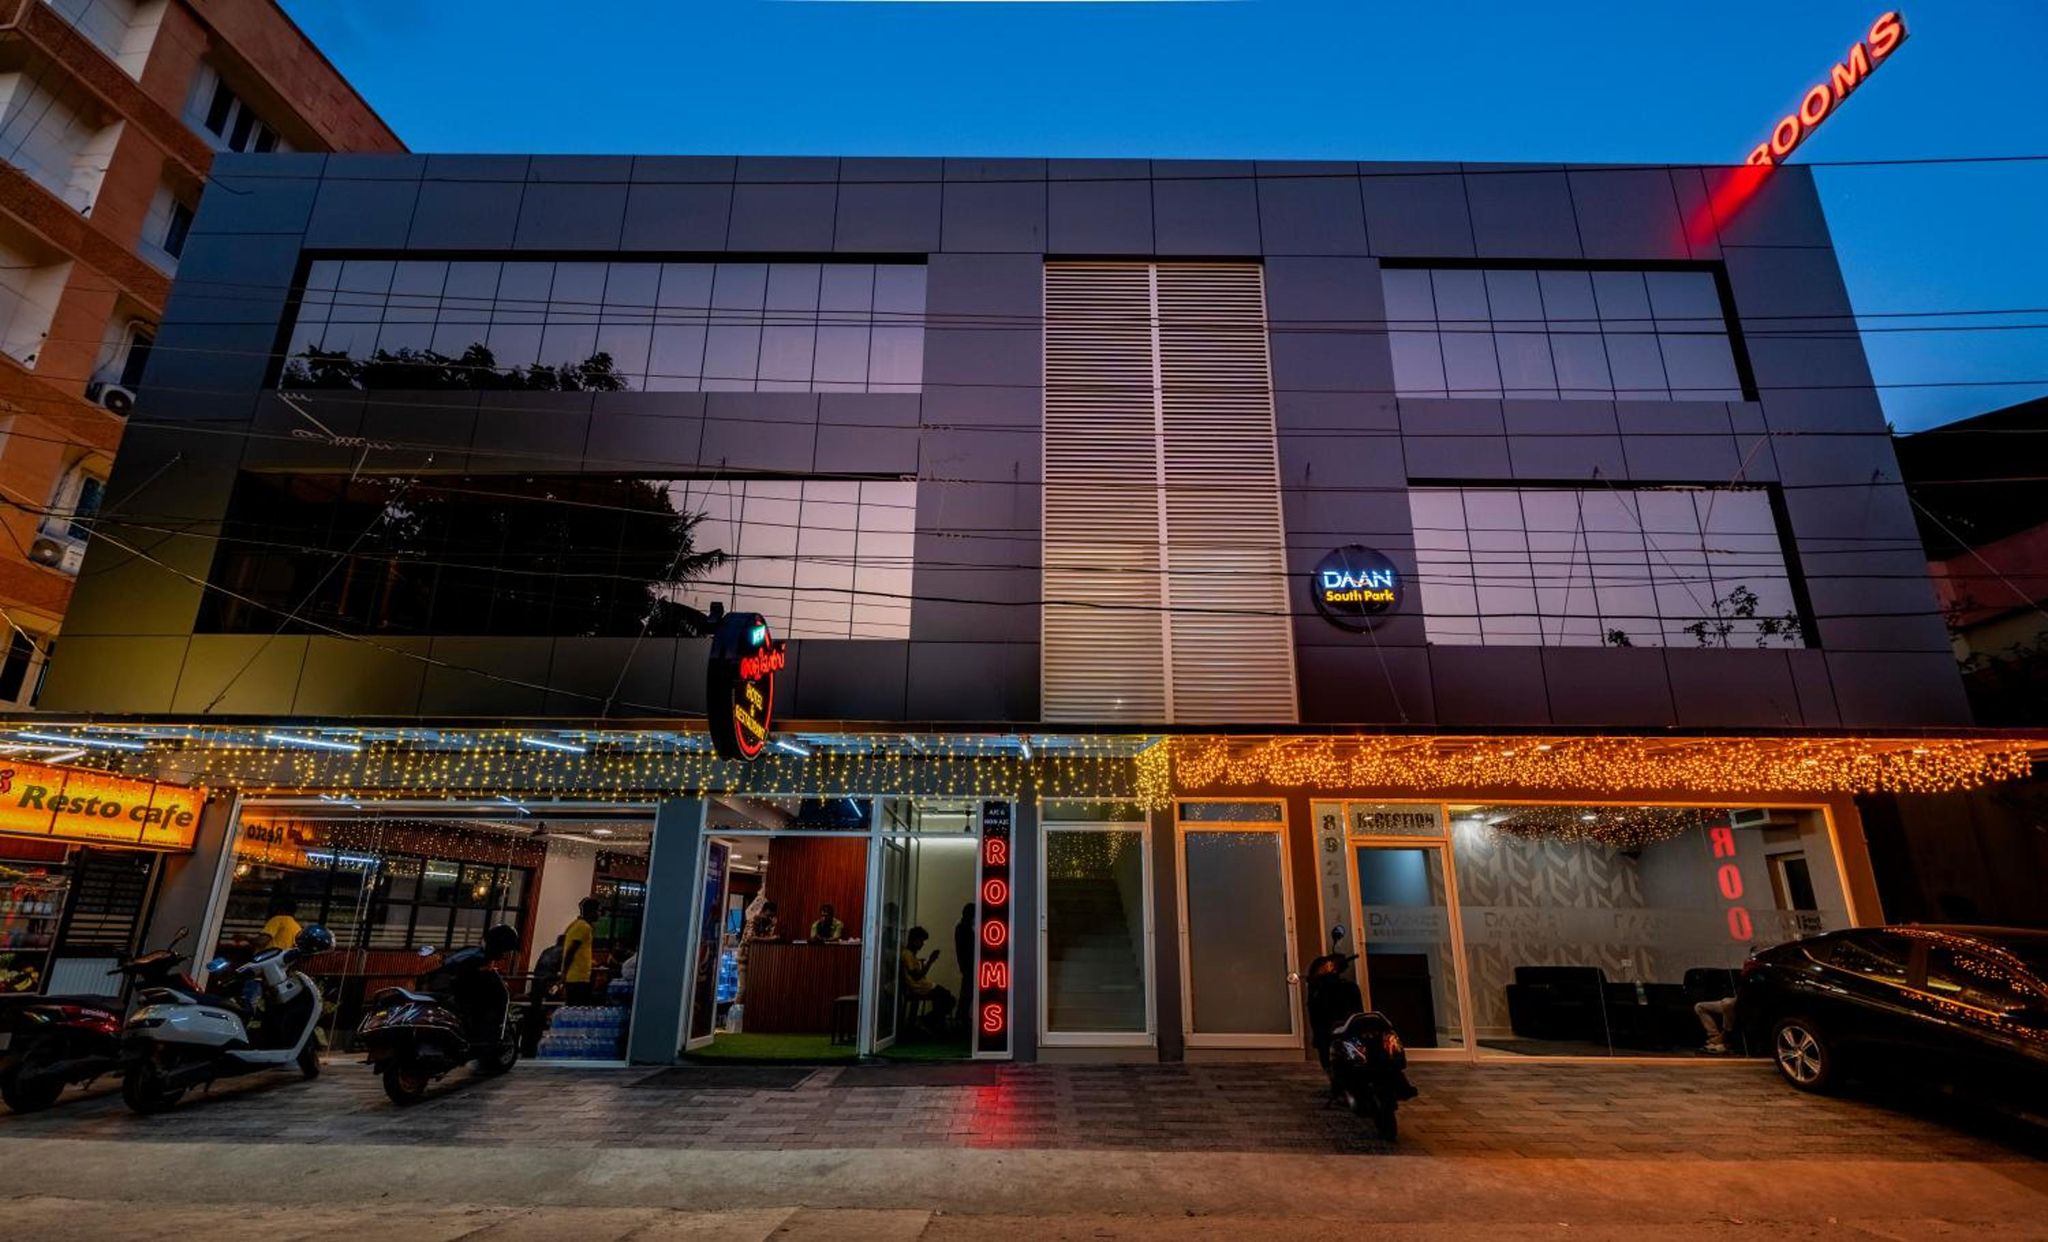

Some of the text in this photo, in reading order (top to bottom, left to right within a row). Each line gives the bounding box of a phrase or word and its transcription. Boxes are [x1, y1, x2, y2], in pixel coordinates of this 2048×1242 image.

[1323, 570, 1392, 588] DAAN
[1326, 589, 1395, 602] South Park
[17, 784, 195, 830] Resto cafe
[1356, 811, 1436, 830] RECEPTION
[981, 838, 1007, 1032] ROOMS
